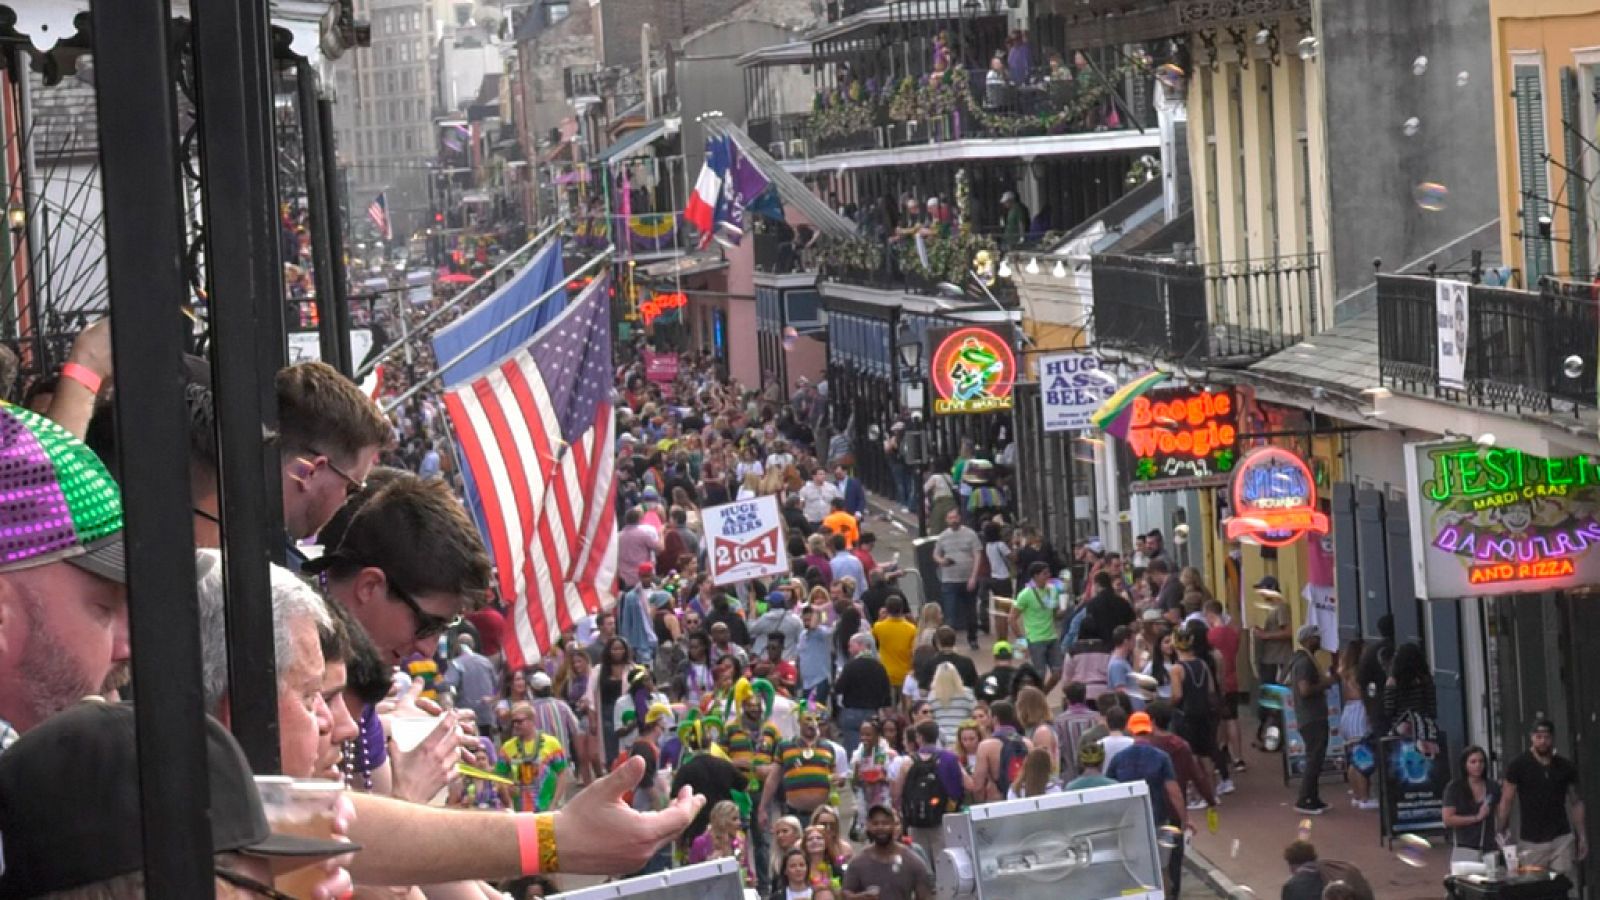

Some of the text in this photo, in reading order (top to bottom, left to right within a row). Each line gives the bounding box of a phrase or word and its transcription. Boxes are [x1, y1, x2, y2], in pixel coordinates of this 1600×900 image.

[1046, 356, 1112, 375] HUGE
[1050, 373, 1108, 389] ASS
[1132, 391, 1230, 426] Boogie
[1129, 420, 1235, 457] Woogie
[1473, 484, 1567, 510] MARDI GRAS
[721, 503, 757, 517] HUGE
[724, 512, 757, 526] ASS
[722, 519, 762, 535] BEERS
[716, 536, 775, 566] 2 for 1
[1471, 566, 1514, 583] AND
